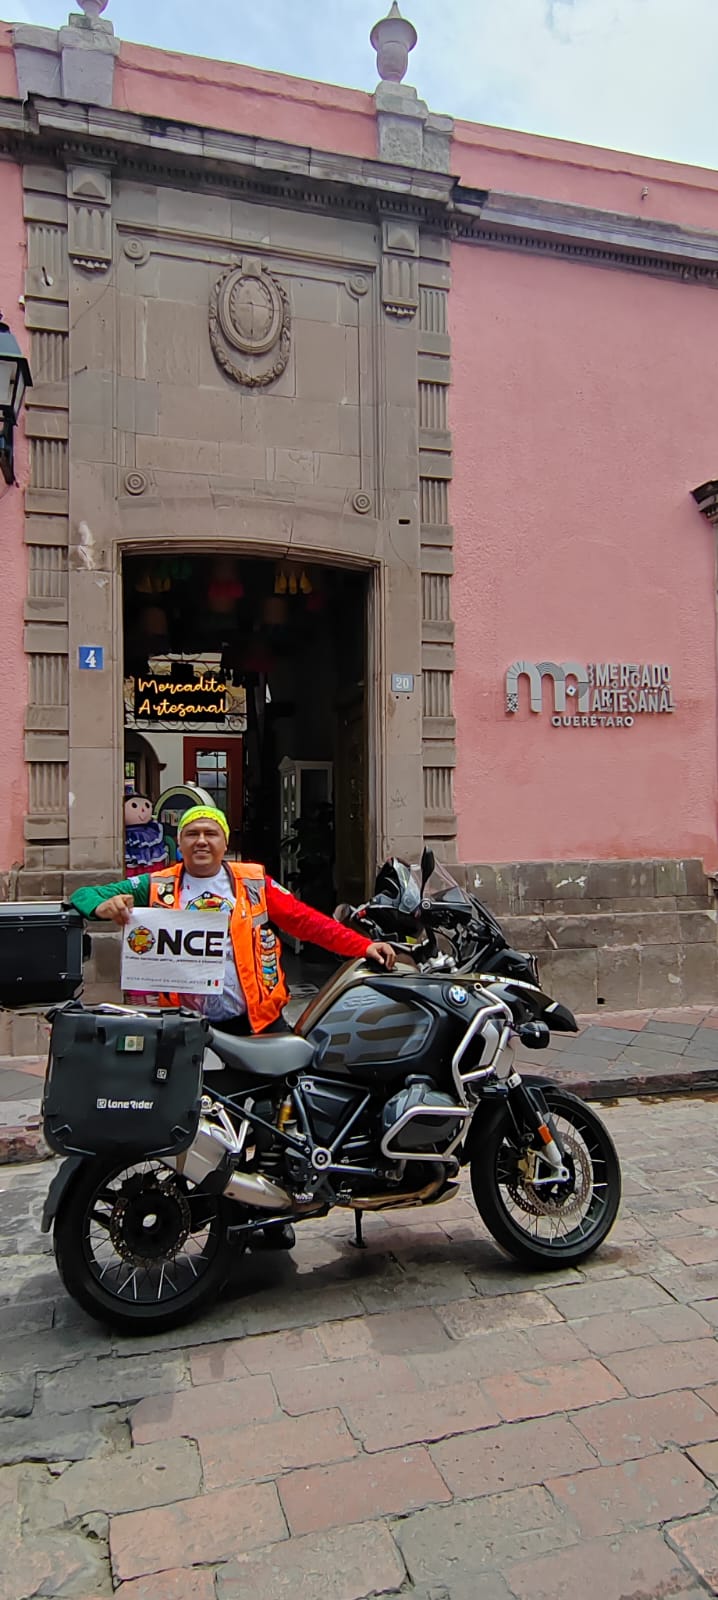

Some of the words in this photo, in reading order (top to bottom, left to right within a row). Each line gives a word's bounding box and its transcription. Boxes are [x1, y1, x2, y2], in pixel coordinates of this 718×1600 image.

[85, 649, 97, 668] 4
[138, 676, 227, 694] Mercadito
[395, 676, 409, 689] 20
[596, 663, 672, 688] MERCADO
[138, 698, 228, 717] Artesanal
[592, 687, 676, 712] ARTESANAL
